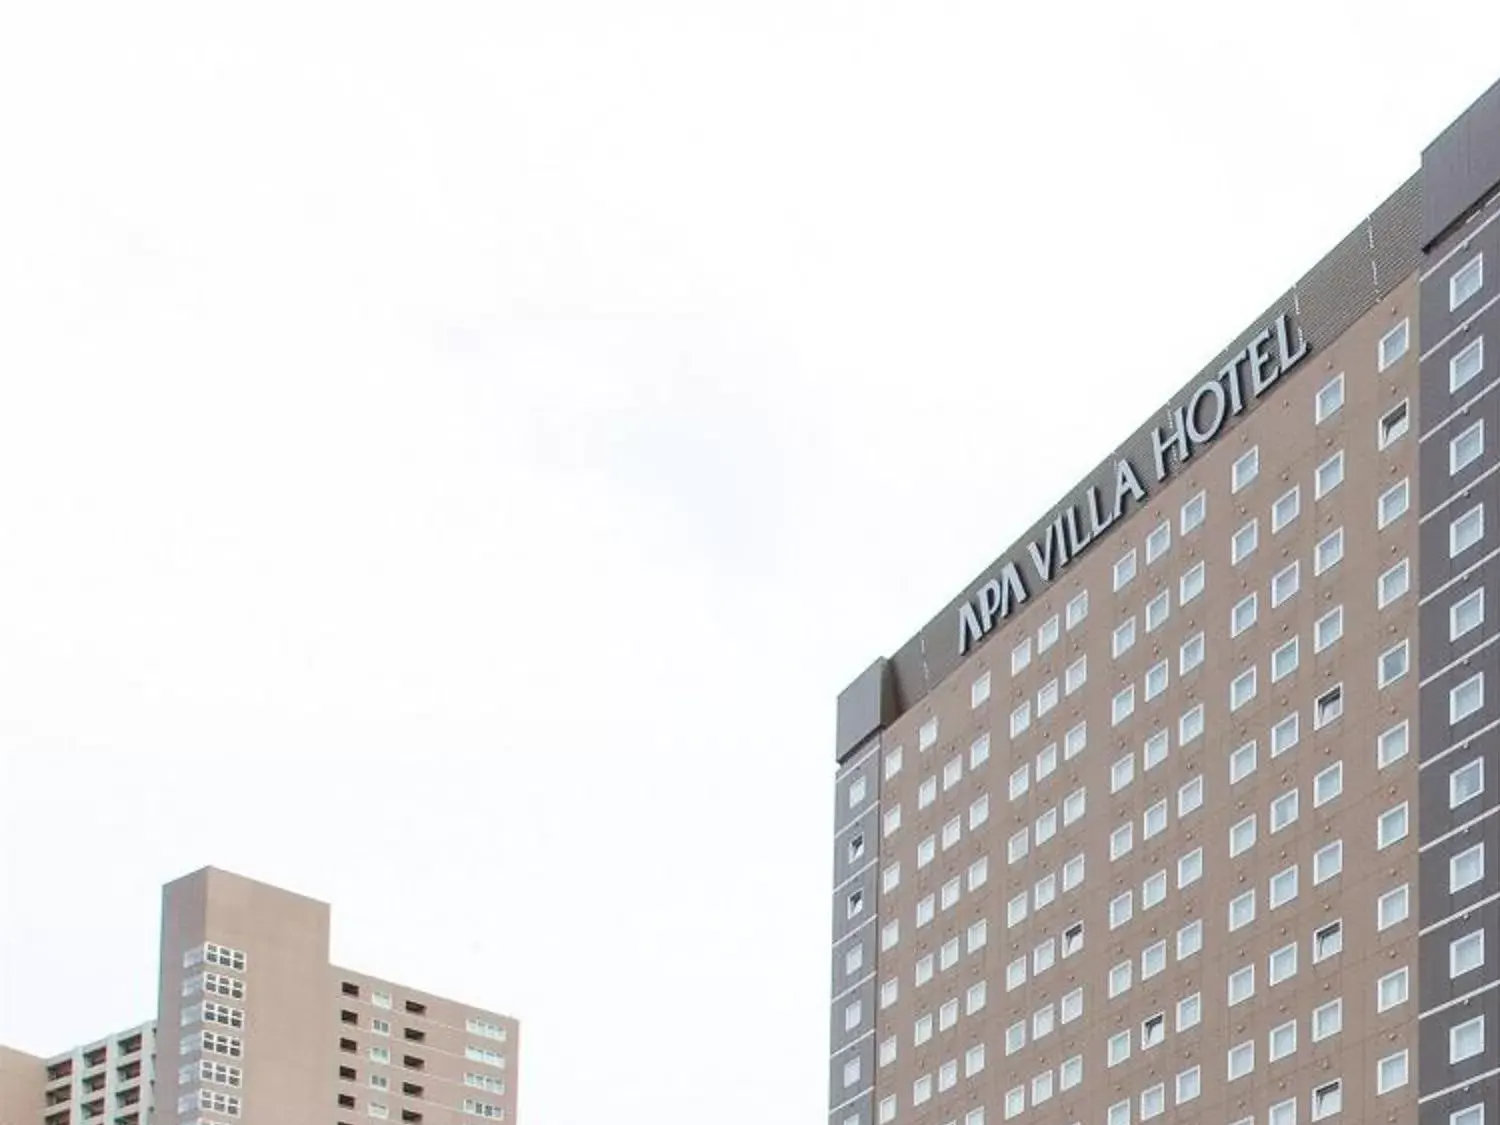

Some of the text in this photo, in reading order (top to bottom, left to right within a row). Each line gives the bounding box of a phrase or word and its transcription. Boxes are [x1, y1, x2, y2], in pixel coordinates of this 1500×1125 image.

[958, 313, 1312, 655] APA VILLA HOTEL
